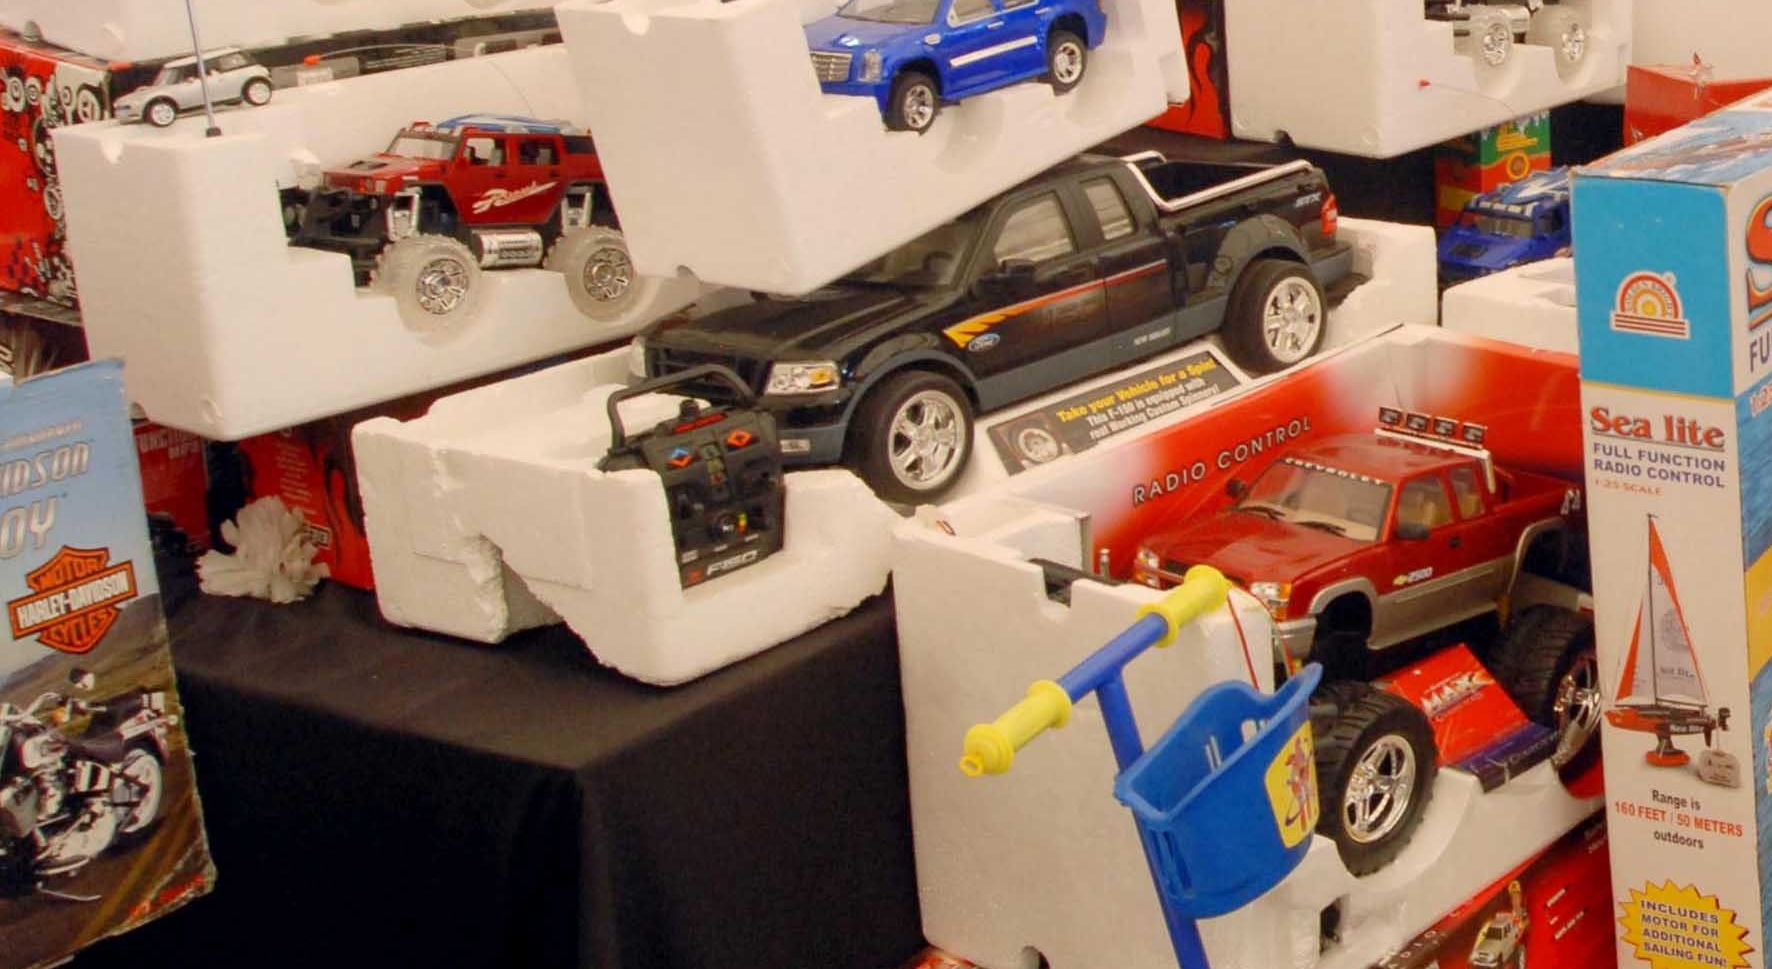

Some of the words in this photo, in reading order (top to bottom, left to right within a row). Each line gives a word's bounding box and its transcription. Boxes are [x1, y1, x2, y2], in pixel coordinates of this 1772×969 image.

[1590, 406, 1652, 439] Sea
[1663, 414, 1726, 449] lite
[1133, 462, 1206, 507] RADIO
[1217, 415, 1312, 469] CONTROL
[1593, 442, 1632, 460] FULL
[1638, 449, 1726, 472] FUNCTION
[1594, 458, 1642, 477] RADIO
[1647, 466, 1726, 488] CONTROL
[1652, 789, 1688, 810] Range
[1691, 797, 1701, 810] is
[1615, 800, 1635, 817] 160
[1638, 807, 1667, 822] FEET
[1677, 813, 1690, 827] 50
[1694, 817, 1744, 837] METERS
[1653, 830, 1704, 850] outdoors
[1641, 900, 1719, 924] INCLUDES
[1641, 914, 1688, 932] MOTOR
[1693, 924, 1719, 938] FOR
[1642, 928, 1722, 953] ADDITIONAL
[1644, 941, 1694, 961] SAILING
[1697, 952, 1728, 968] FUN!
